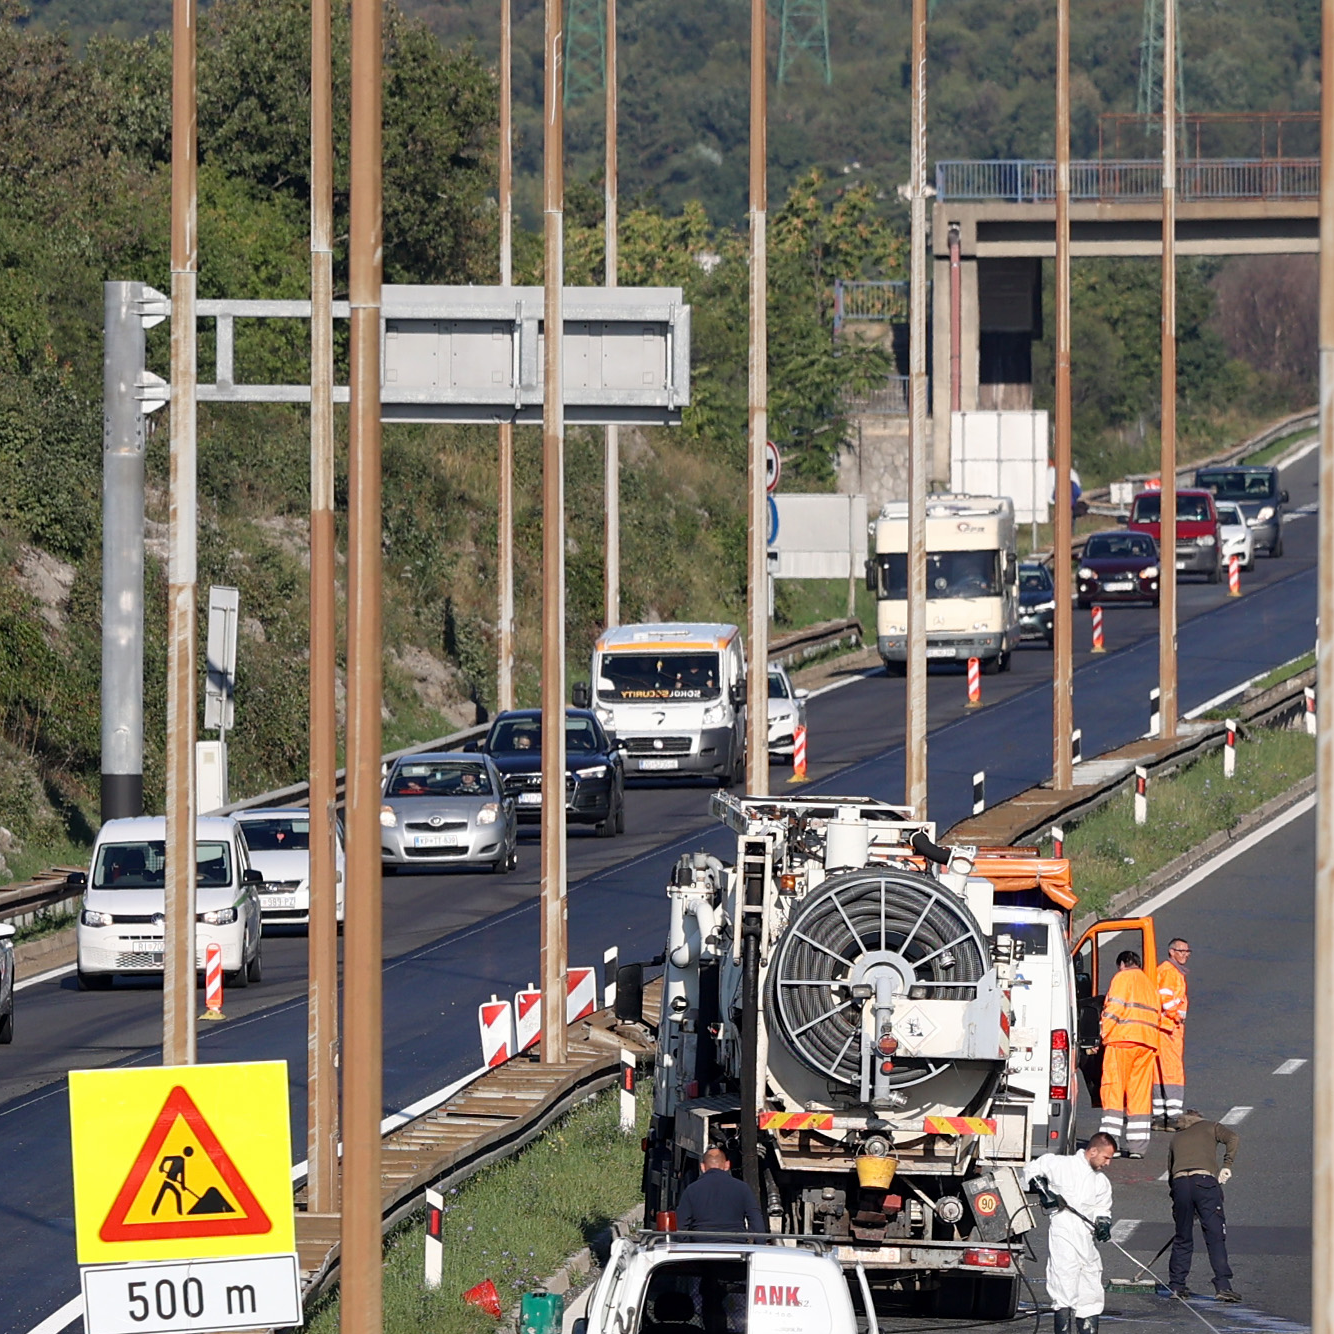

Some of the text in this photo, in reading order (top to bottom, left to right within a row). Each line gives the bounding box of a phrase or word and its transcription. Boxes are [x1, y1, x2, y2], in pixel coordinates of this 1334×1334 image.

[981, 1198, 993, 1210] 90
[127, 1277, 256, 1322] 500 m
